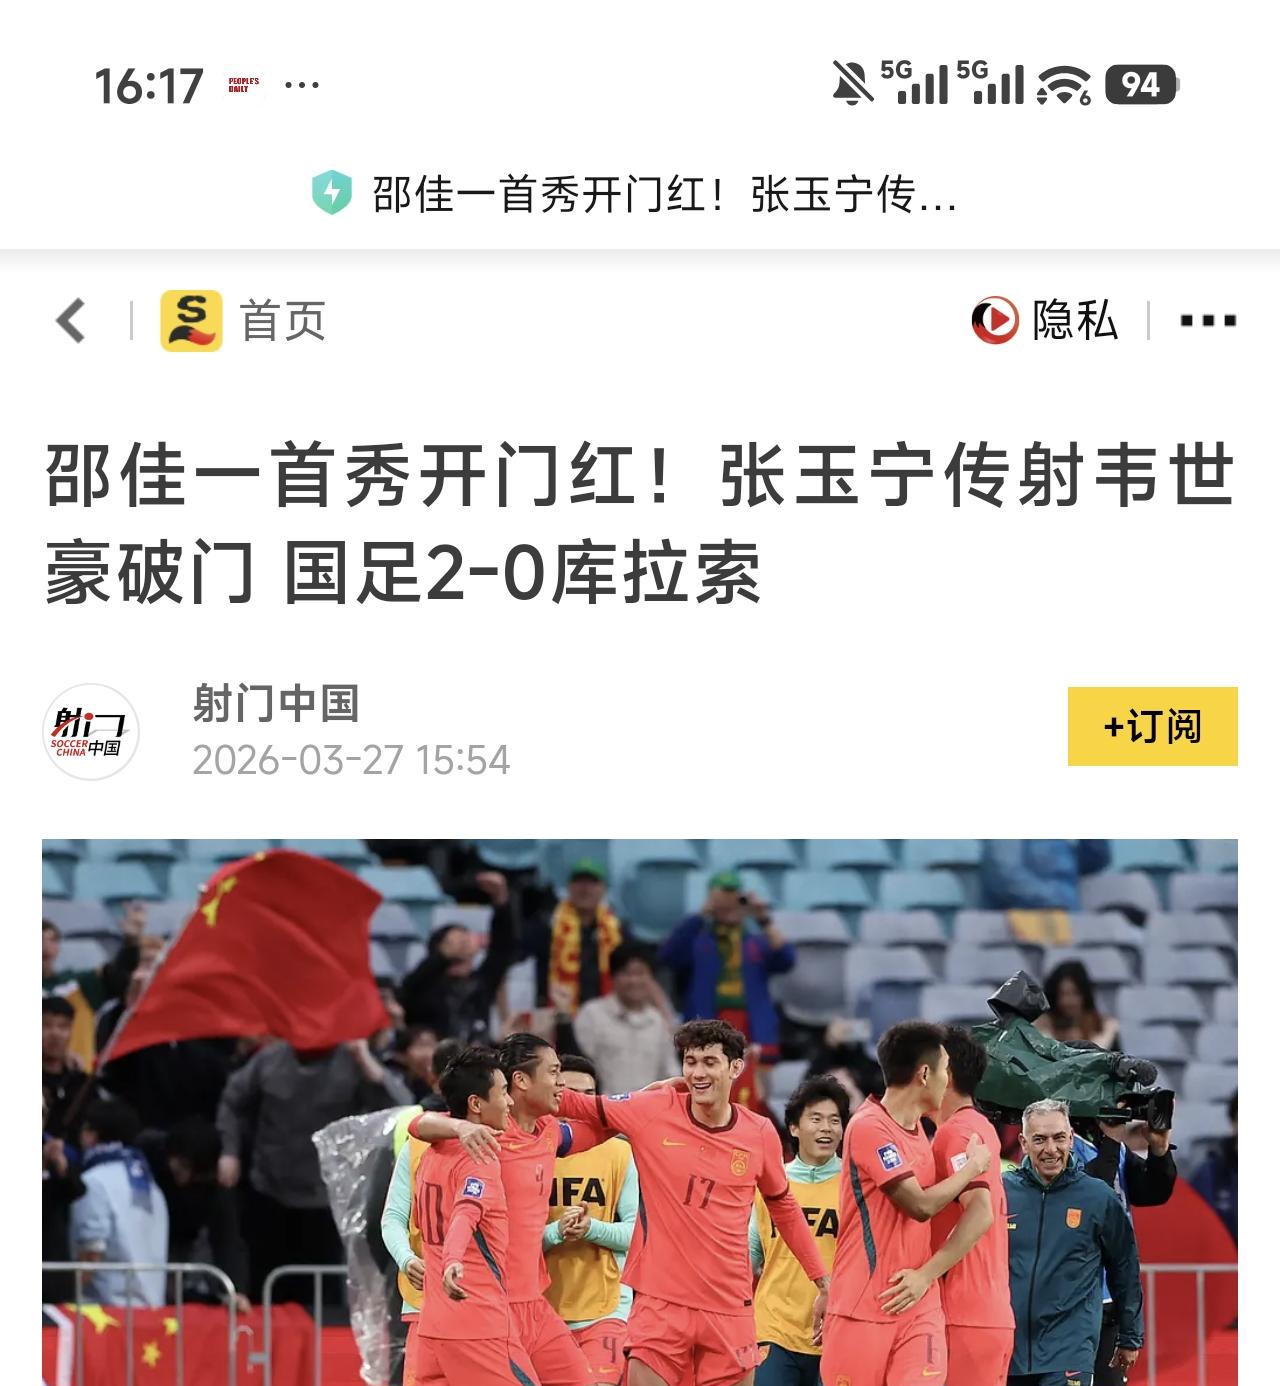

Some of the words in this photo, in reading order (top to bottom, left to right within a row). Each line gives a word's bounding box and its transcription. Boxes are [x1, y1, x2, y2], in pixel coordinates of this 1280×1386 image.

[95, 68, 204, 104] 16:17
[880, 60, 913, 79] 5G
[956, 60, 989, 79] 5G
[1121, 71, 1161, 97] 94
[1080, 90, 1092, 106] 6
[239, 298, 326, 342] 首页
[1033, 298, 1119, 341] 隐私
[46, 440, 1234, 508] 邵佳一首秀开门红！张玉宁传射韦世
[46, 538, 252, 605] 豪破门
[286, 538, 761, 605] 国足2-0库拉索
[193, 683, 358, 723] 射门中国
[1103, 708, 1201, 744] +订阅
[51, 740, 89, 748] SOCCER
[88, 740, 121, 756] 中国
[193, 744, 404, 776] 2026-03-27
[417, 744, 511, 776] 15:54
[549, 1177, 607, 1207] IFA
[683, 1174, 716, 1209] 17
